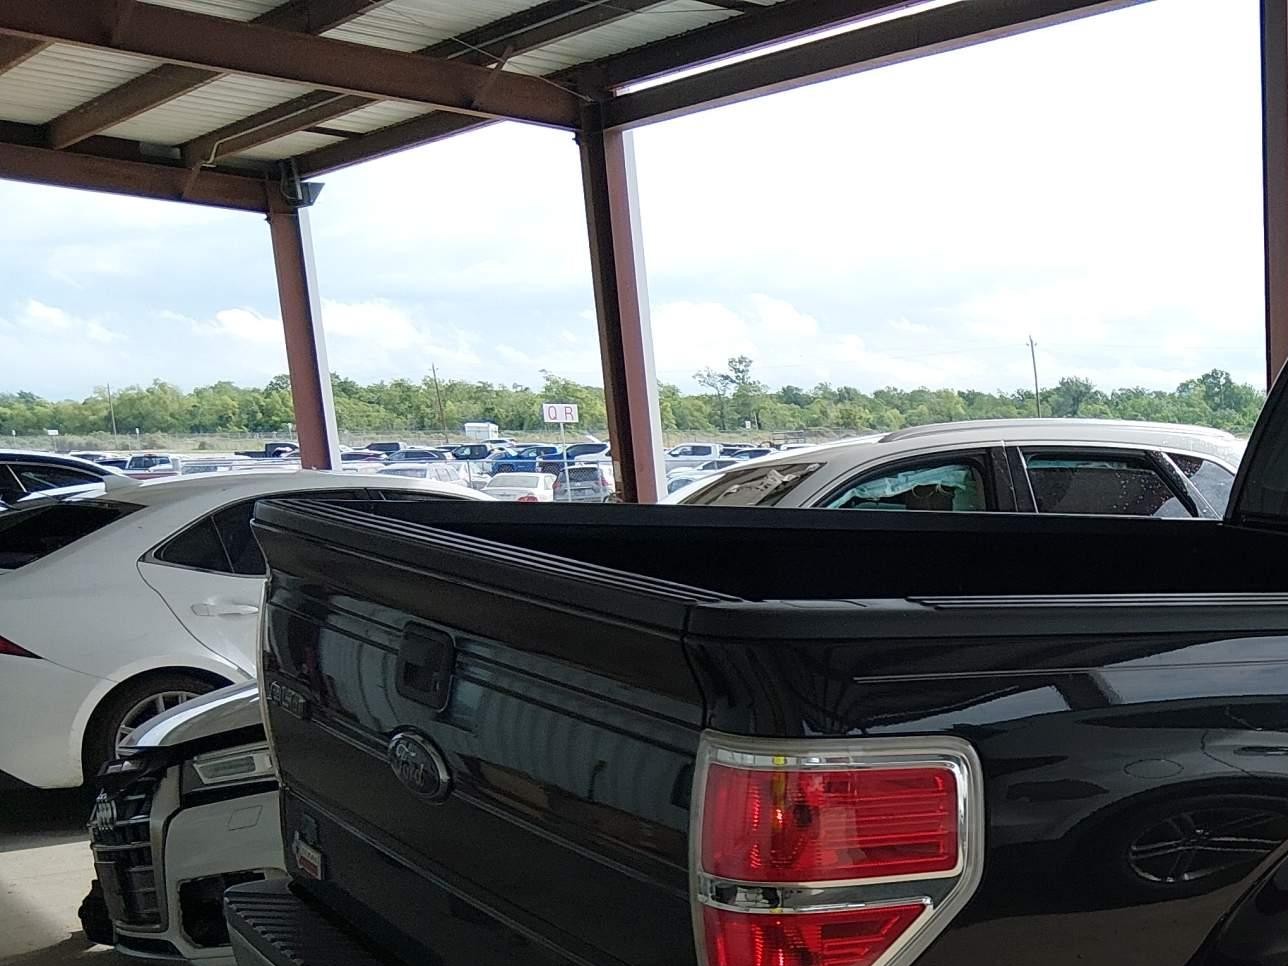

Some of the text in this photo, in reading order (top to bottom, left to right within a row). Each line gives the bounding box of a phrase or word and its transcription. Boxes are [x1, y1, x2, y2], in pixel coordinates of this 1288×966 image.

[547, 405, 574, 421] Q R
[395, 743, 425, 788] Ford
